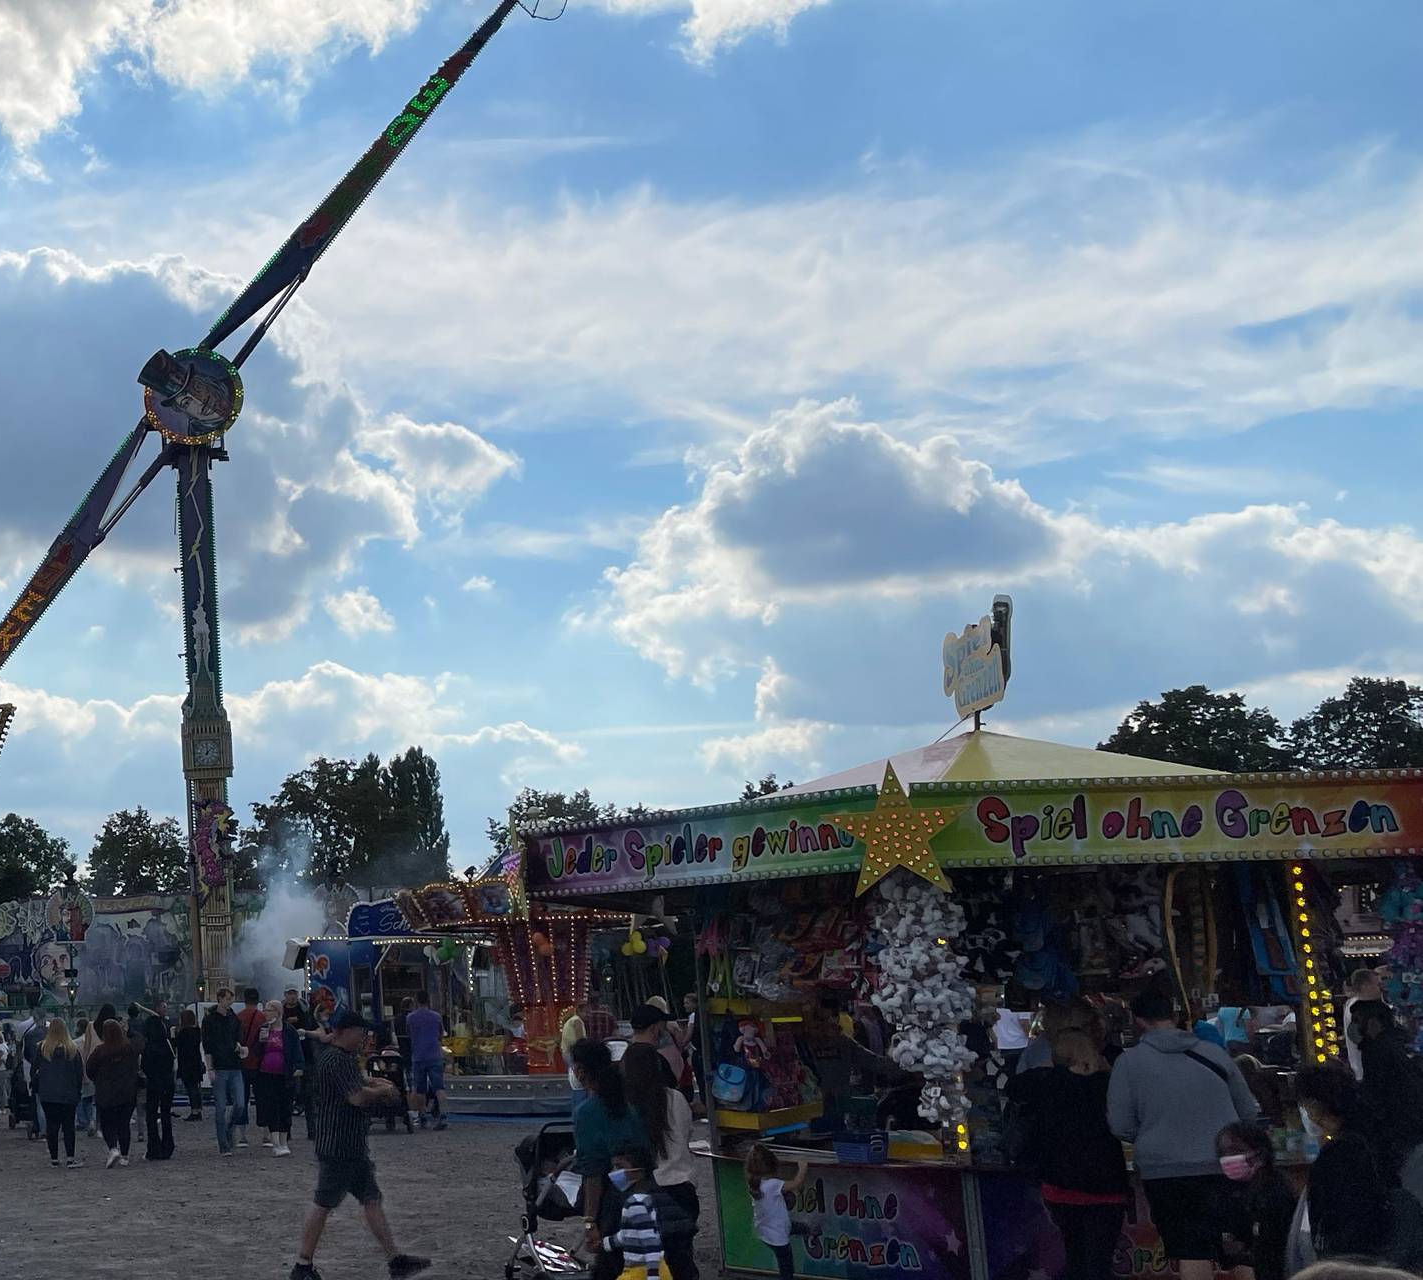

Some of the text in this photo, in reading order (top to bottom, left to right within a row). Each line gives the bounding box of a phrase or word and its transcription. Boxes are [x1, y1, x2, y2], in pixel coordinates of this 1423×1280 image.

[546, 836, 618, 880] Jeder
[623, 823, 723, 883] Spieler
[976, 789, 1400, 858] Spiel ohne Grenzen
[833, 1183, 899, 1221] ohne
